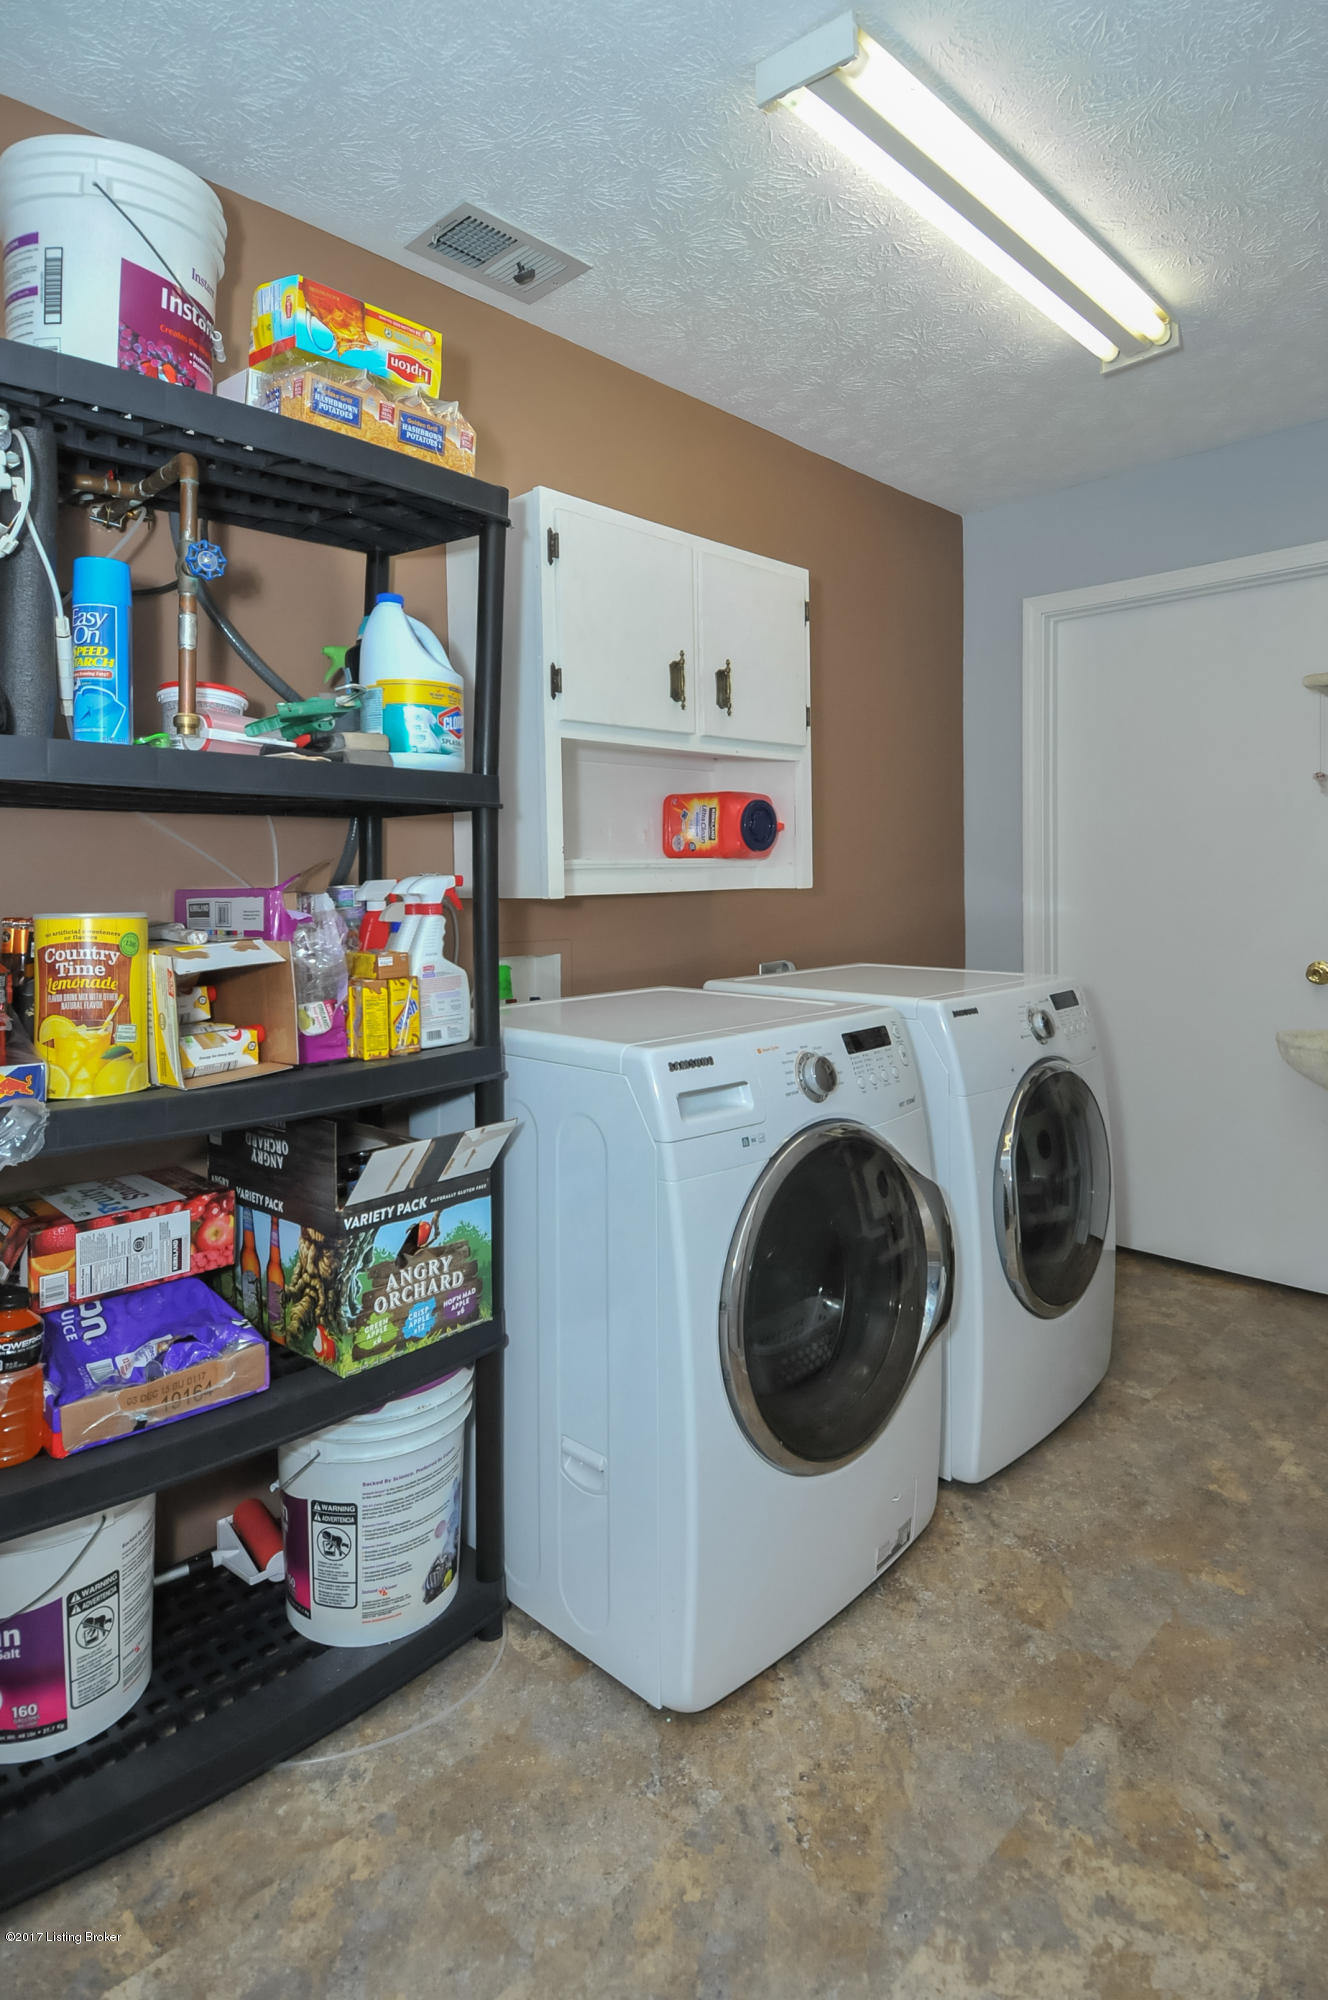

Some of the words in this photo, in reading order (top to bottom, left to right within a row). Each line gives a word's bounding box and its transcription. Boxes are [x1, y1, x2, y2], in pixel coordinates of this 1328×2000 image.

[390, 356, 429, 384] Lipton
[314, 391, 358, 414] HASHBROWN
[319, 402, 354, 420] POTATOES
[406, 431, 438, 447] POTATOES
[73, 625, 100, 644] On
[52, 928, 80, 937] artificial
[44, 946, 120, 966] Country
[55, 961, 106, 977] Time
[47, 976, 119, 995] Lemonade
[245, 1131, 289, 1155] ORCHARD
[250, 1147, 284, 1169] ANGRY
[235, 1185, 264, 1207] VARIETY
[264, 1196, 284, 1213] PACK
[343, 1204, 395, 1231] VARIETY
[396, 1195, 428, 1216] PACK
[386, 1255, 453, 1292] ANGRY
[373, 1270, 465, 1315] ORCHARD
[462, 1287, 477, 1300] MAD
[407, 1305, 430, 1320] CRISP
[450, 1298, 470, 1312] APPLE
[364, 1316, 389, 1334] GREEN
[408, 1313, 431, 1330] APPLE
[366, 1325, 388, 1341] APPLE
[140, 1389, 159, 1403] DEC
[321, 1503, 356, 1514] WARNING
[321, 1514, 355, 1524] ADVERTENCIA
[80, 1572, 118, 1598] WARNING
[81, 1585, 118, 1610] ADVERTENCIA
[11, 1703, 38, 1718] 160
